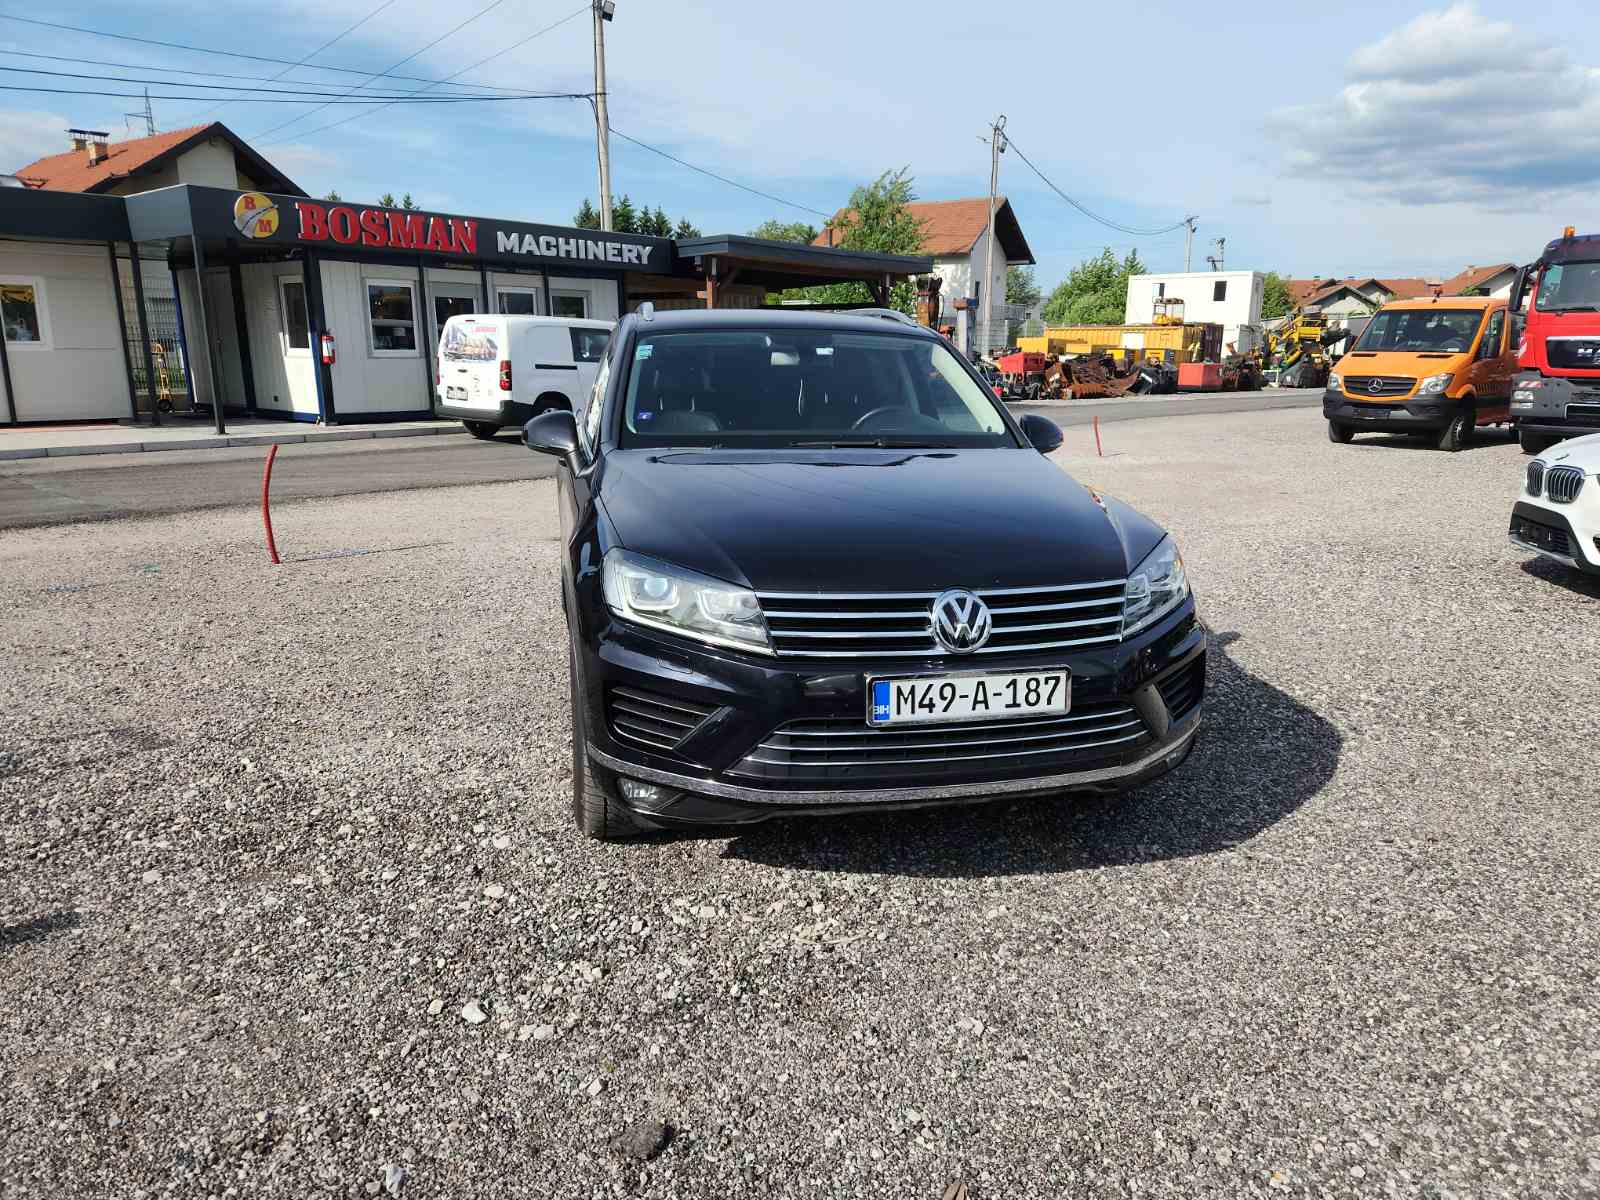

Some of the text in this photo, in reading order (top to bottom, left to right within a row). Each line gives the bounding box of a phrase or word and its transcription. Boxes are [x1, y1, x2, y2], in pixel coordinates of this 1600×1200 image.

[244, 196, 256, 209] B
[256, 218, 273, 233] M
[295, 202, 654, 265] BOSMAN MACHINERY
[933, 590, 990, 650] VW
[896, 675, 1061, 716] M49-A-187
